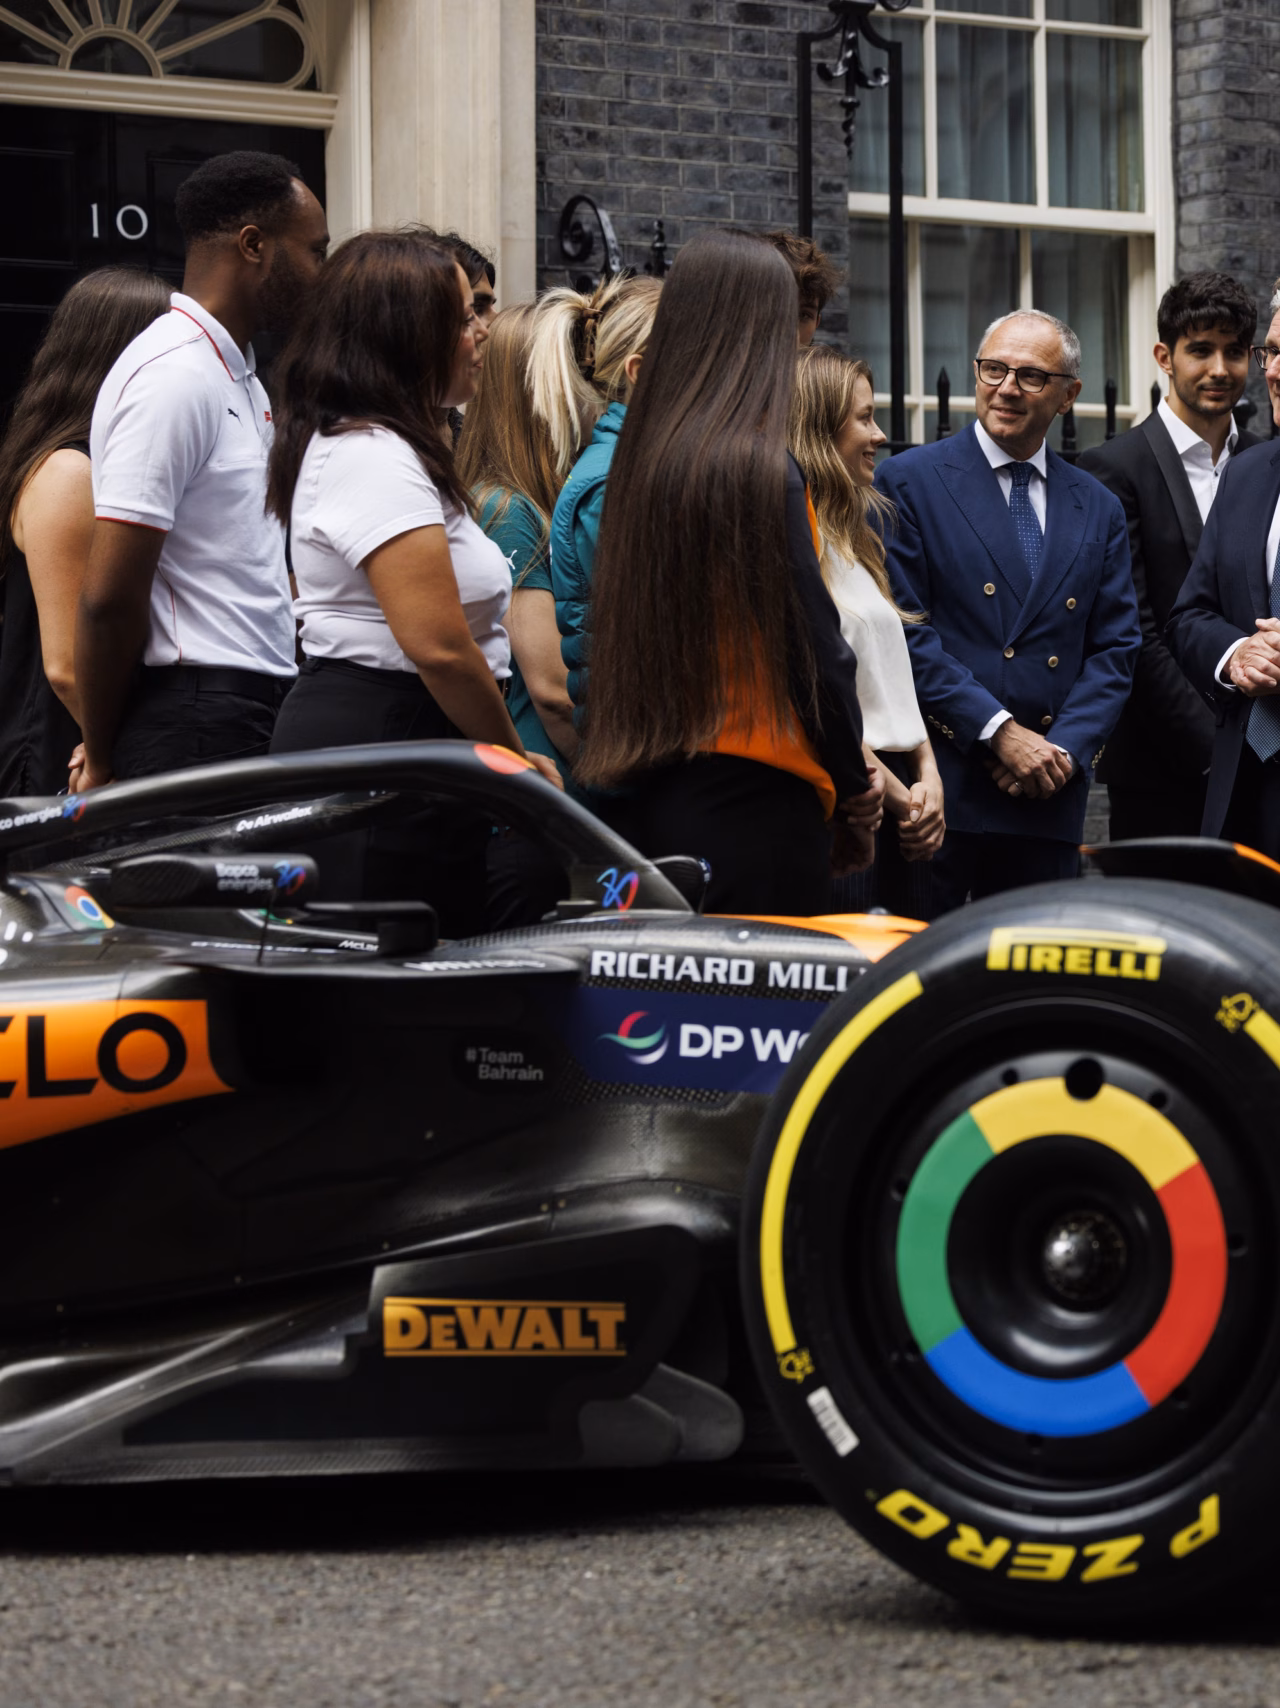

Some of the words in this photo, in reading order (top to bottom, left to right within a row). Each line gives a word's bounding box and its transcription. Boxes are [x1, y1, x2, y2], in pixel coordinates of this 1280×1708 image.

[91, 203, 148, 240] 10
[254, 806, 313, 828] Airwallex
[590, 950, 755, 985] RICHARD
[768, 961, 866, 992] MILL
[987, 927, 1166, 981] PIRELLI
[679, 1023, 744, 1059] DP
[478, 1064, 544, 1080] Bahrain
[876, 1489, 1145, 1583] ZERO
[1170, 1493, 1220, 1559] P
